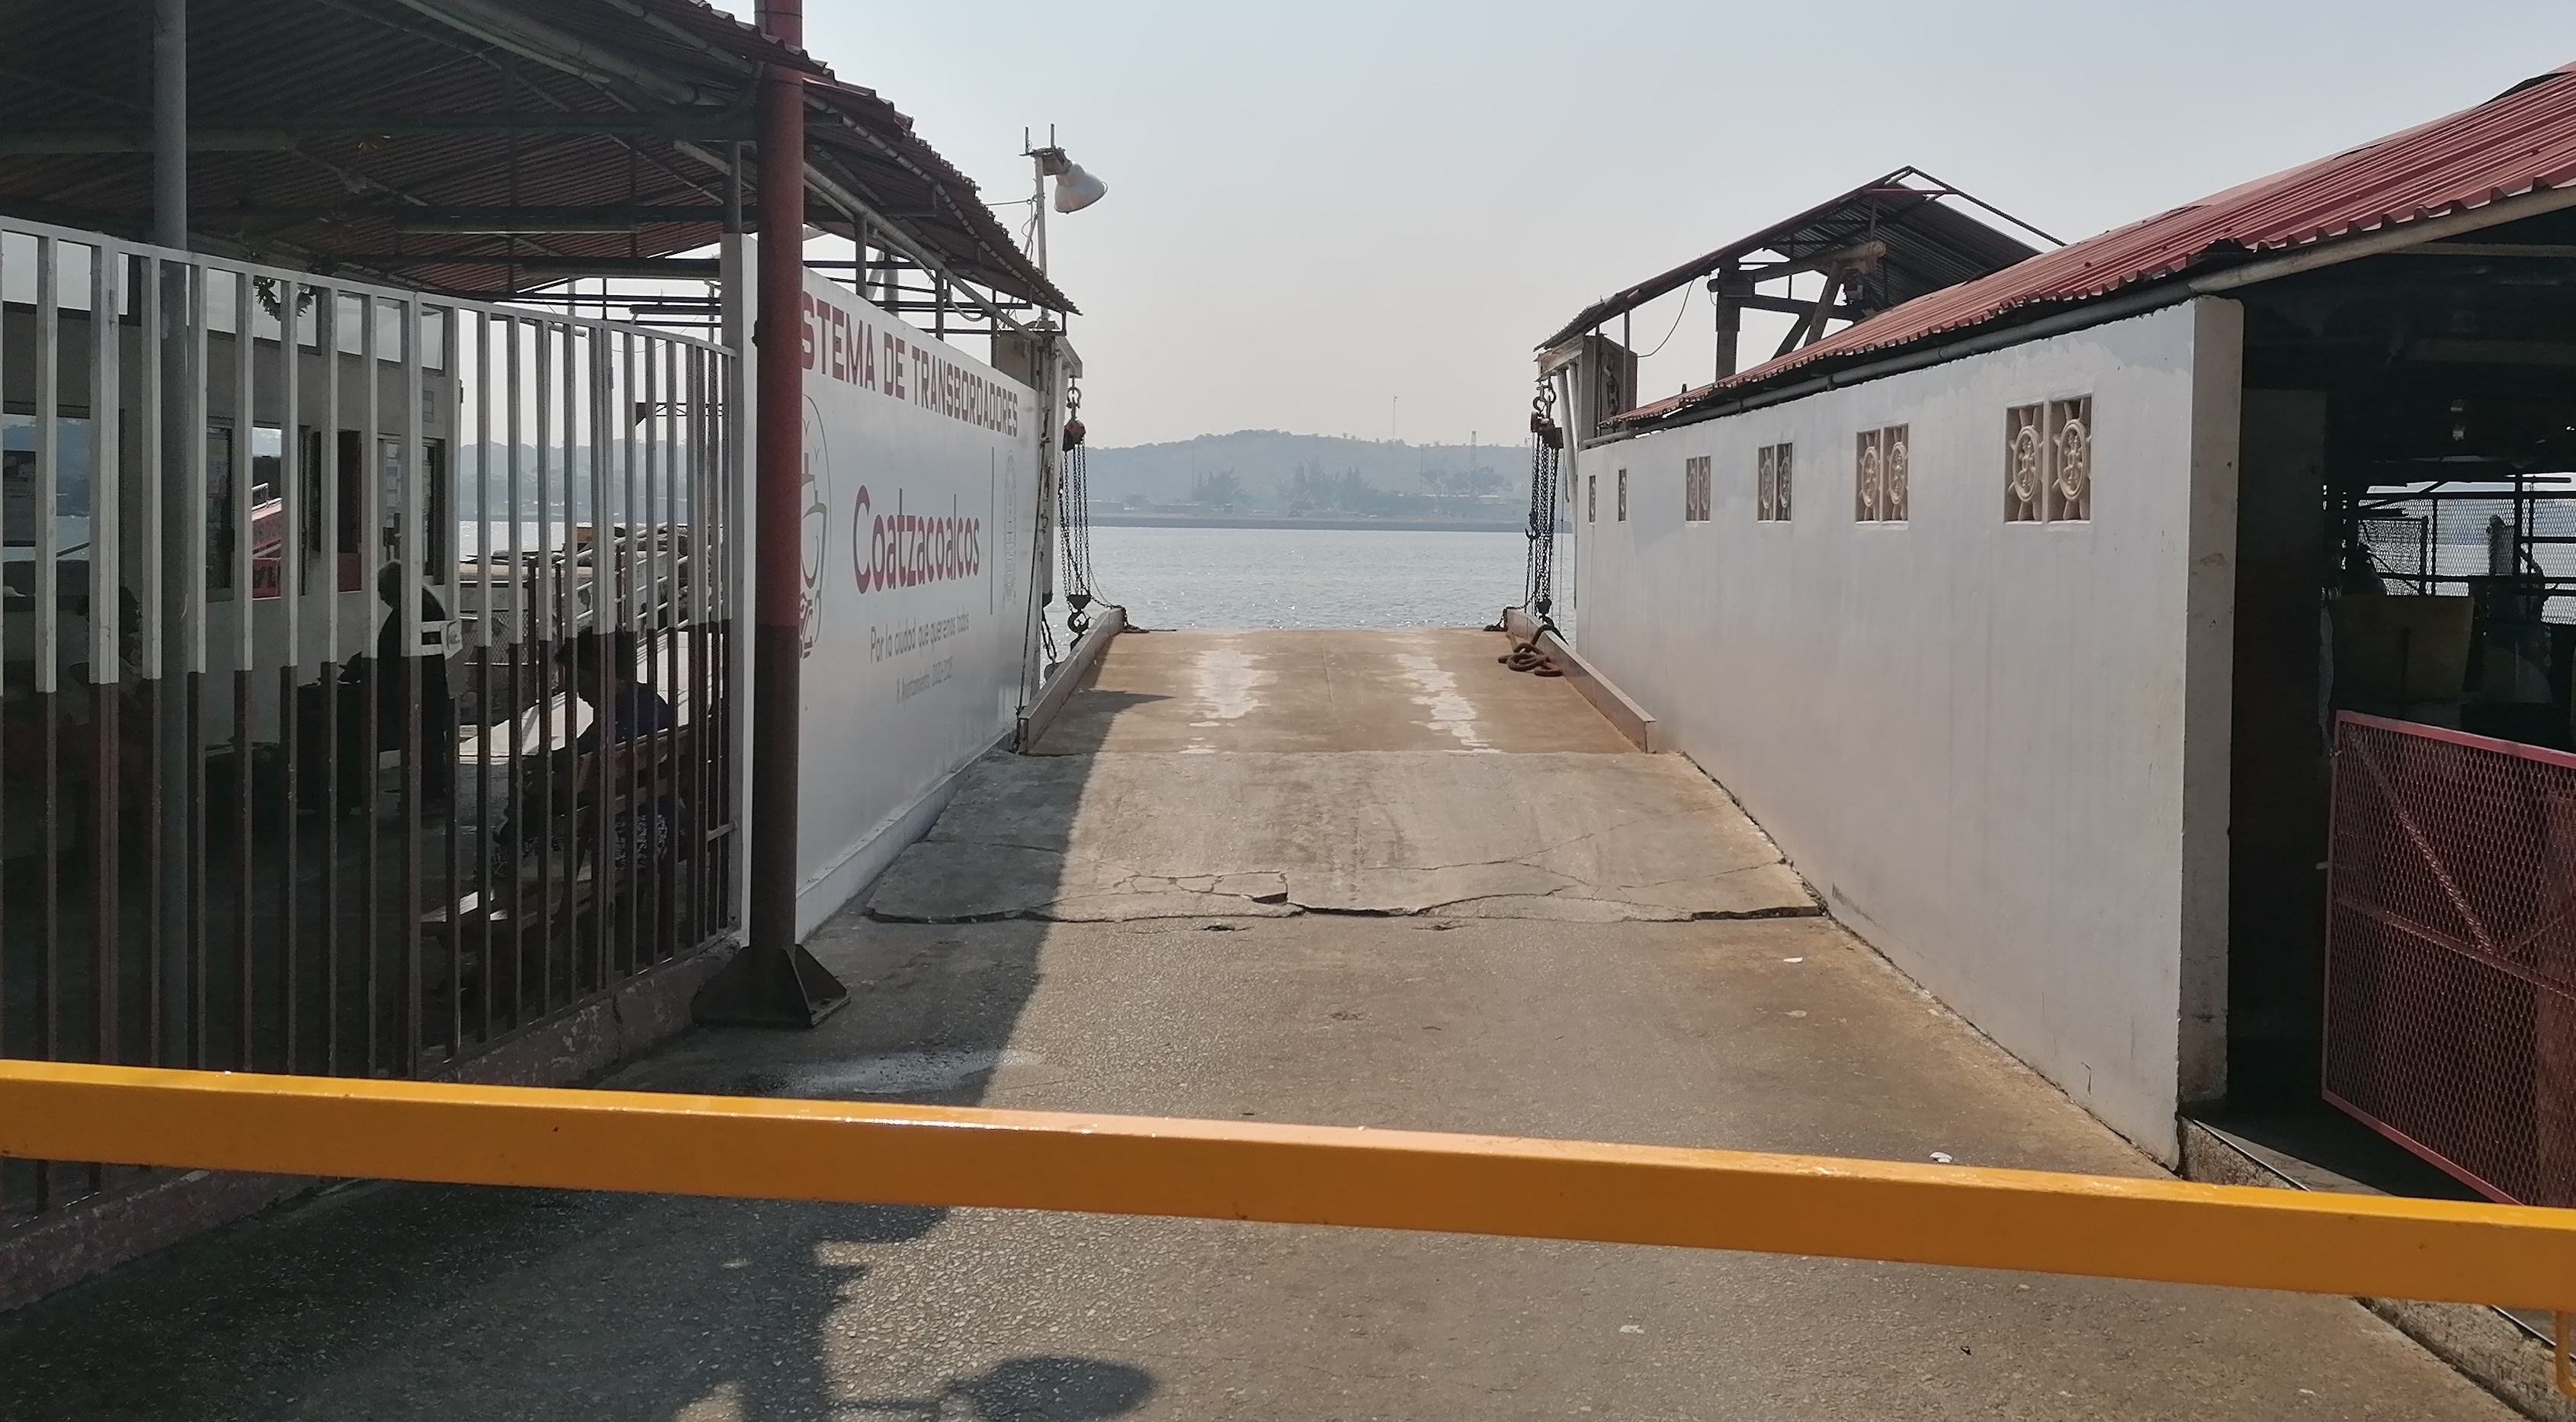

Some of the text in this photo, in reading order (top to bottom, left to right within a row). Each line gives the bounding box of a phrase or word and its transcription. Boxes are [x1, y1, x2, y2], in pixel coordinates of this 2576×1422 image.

[802, 290, 1019, 438] STEMA DE TRANSBORDADORES
[853, 484, 980, 595] Coatzacoalcos
[870, 625, 884, 663] Por
[885, 622, 893, 659] la
